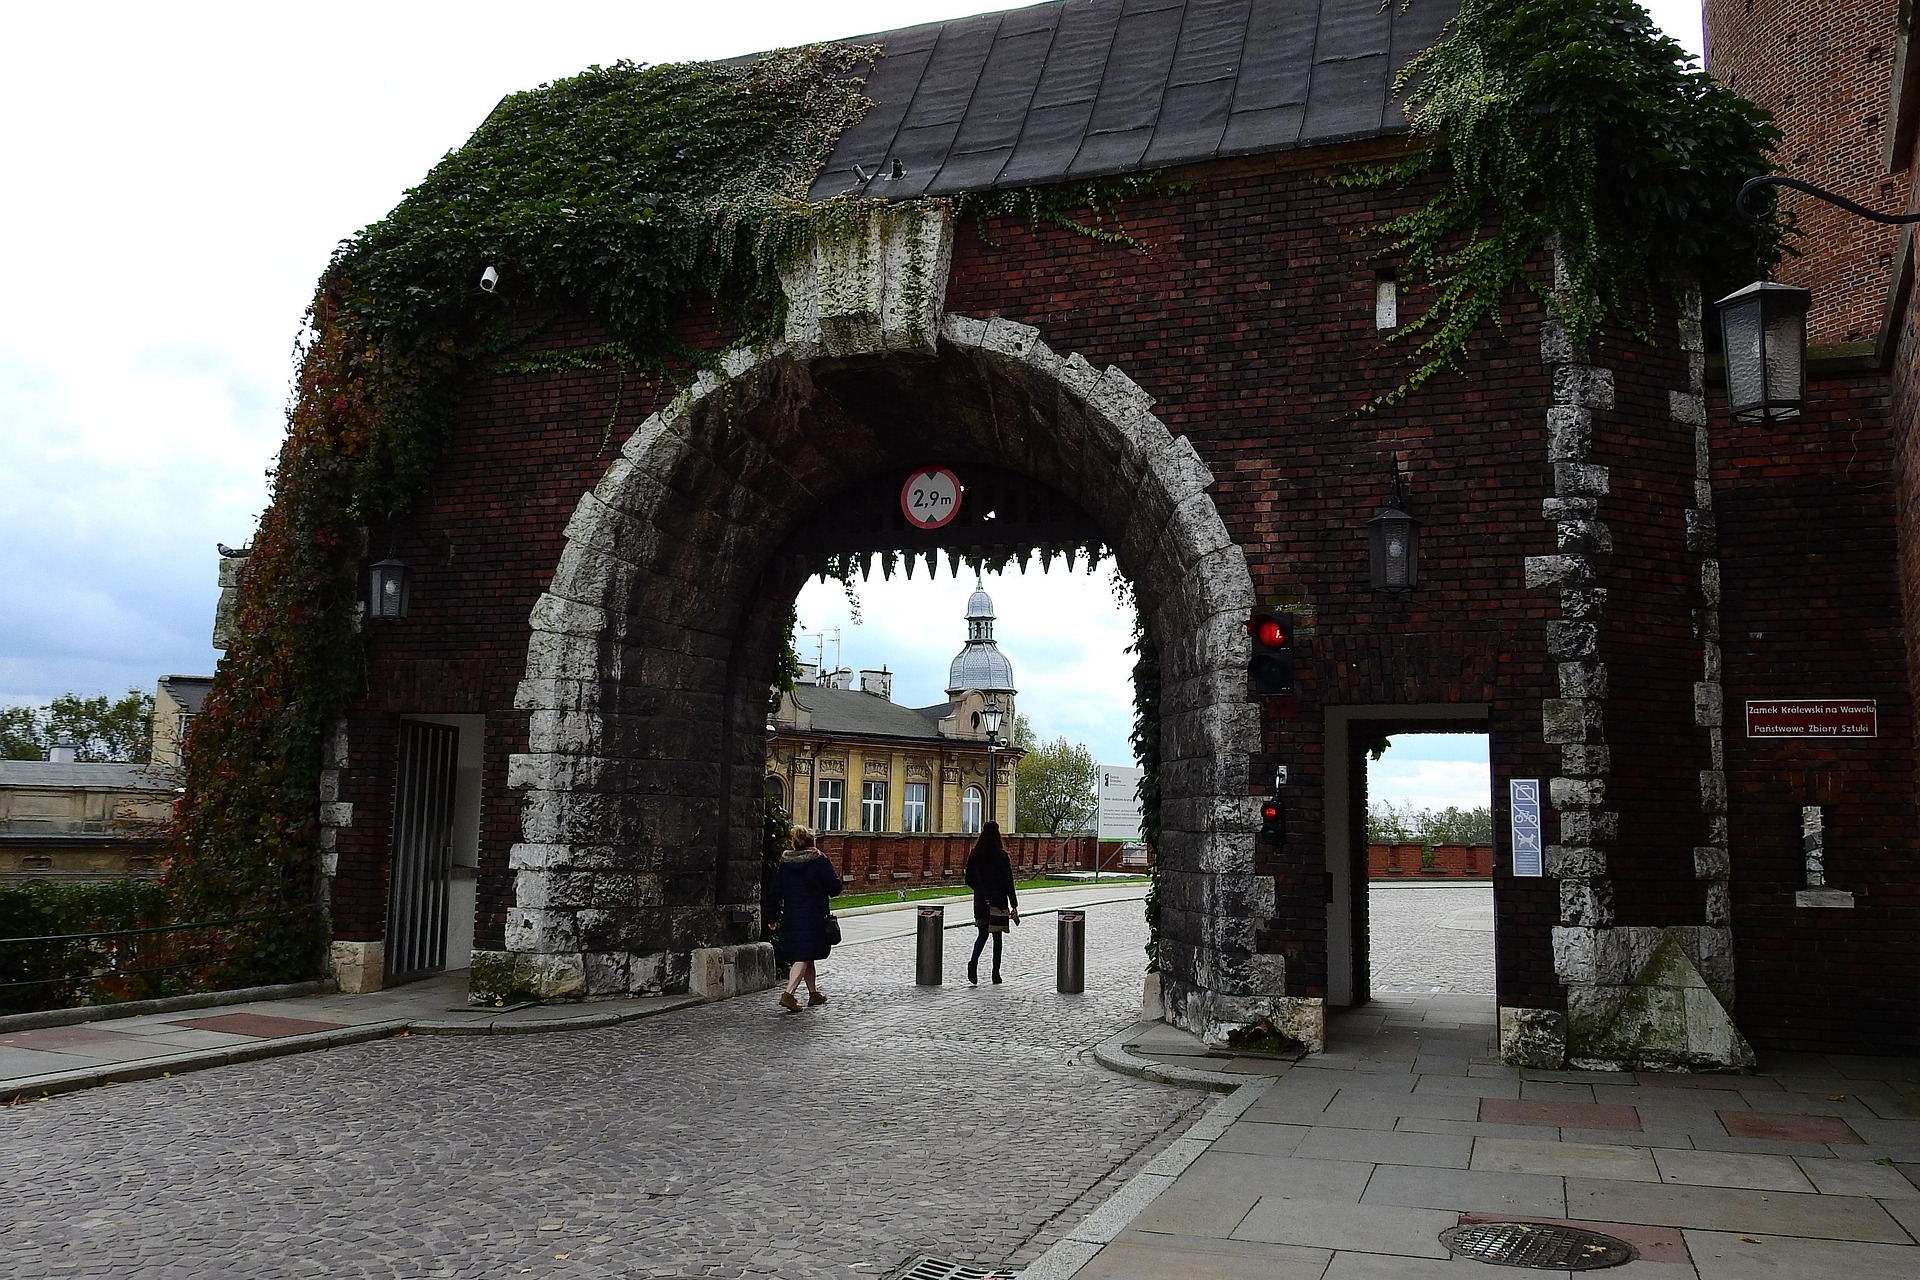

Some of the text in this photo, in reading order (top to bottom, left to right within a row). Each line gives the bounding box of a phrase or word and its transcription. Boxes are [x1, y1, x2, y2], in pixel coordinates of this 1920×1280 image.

[1748, 706, 1778, 714] Zamek
[1781, 705, 1824, 714] Królewski
[1840, 705, 1875, 713] Wawelu
[1754, 724, 1868, 735] Państwowe Zbiory Sztuki
